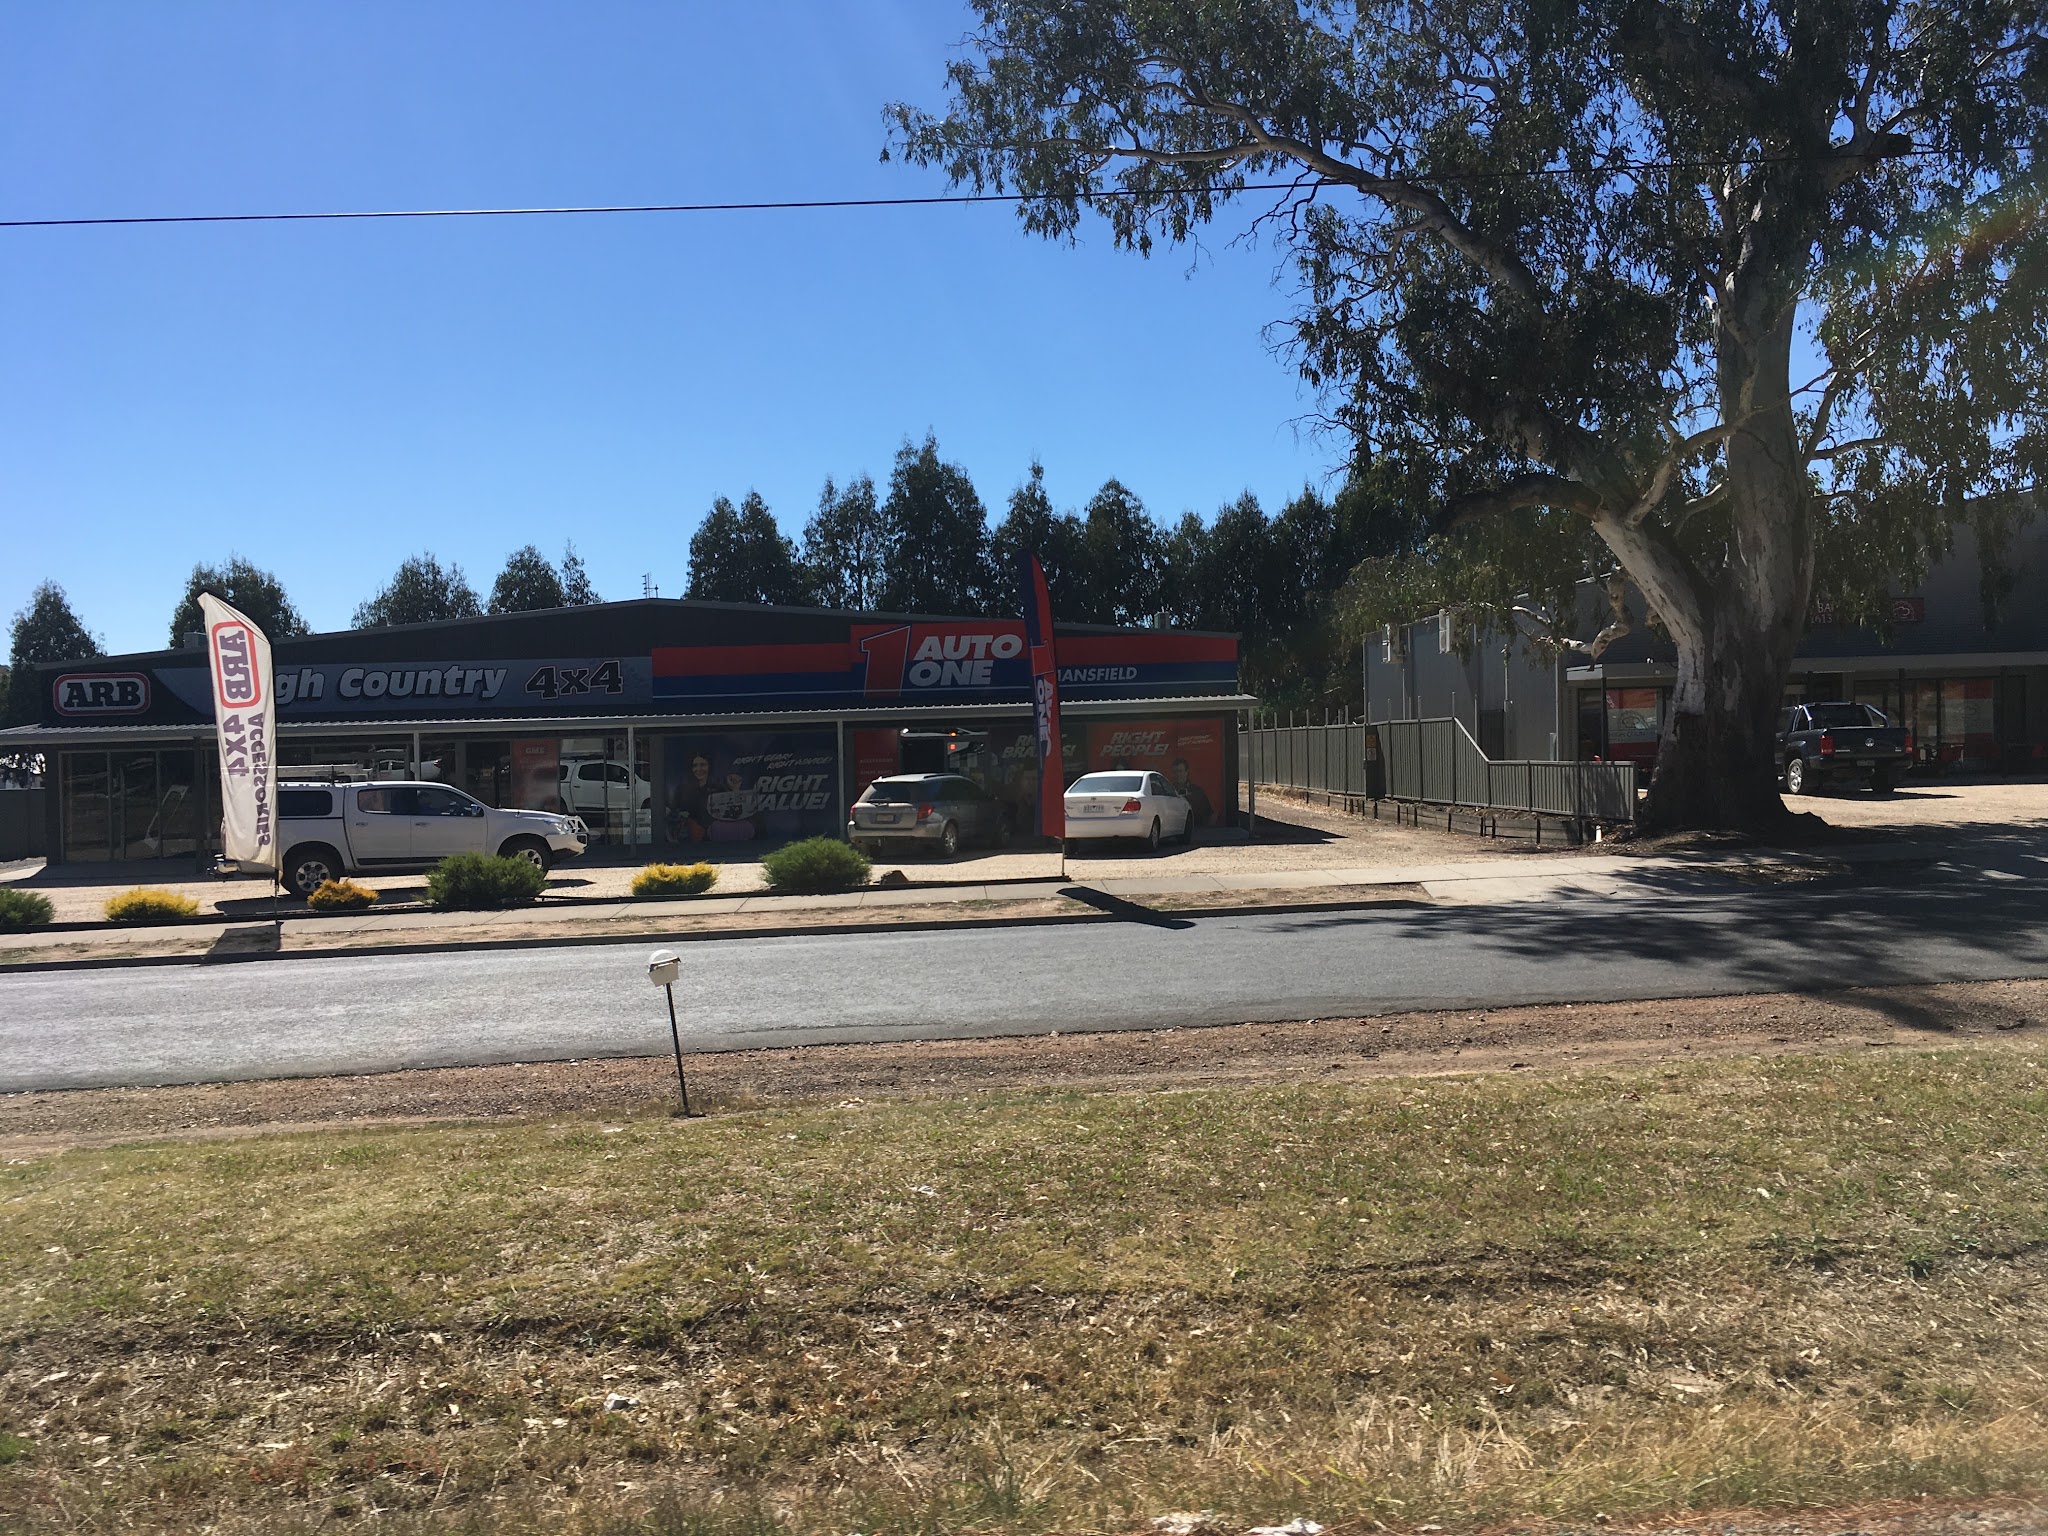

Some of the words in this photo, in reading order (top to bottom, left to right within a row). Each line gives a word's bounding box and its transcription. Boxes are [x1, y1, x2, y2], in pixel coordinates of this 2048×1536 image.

[913, 634, 1023, 661] AUTO
[274, 668, 326, 705] gh
[339, 665, 508, 699] Country
[525, 660, 624, 700] 4x4
[908, 659, 994, 687] ONE
[63, 680, 142, 708] ARB
[1036, 679, 1048, 742] ONE
[1110, 731, 1166, 745] RIGHT
[732, 755, 765, 766] RIGHT
[764, 752, 794, 762] GEAR!
[1002, 745, 1077, 759] BRAS!
[1099, 743, 1170, 757] PEOPLE!
[766, 758, 796, 771] RIGHT
[795, 756, 833, 766] ADVICE!
[757, 774, 829, 793] RIGHT
